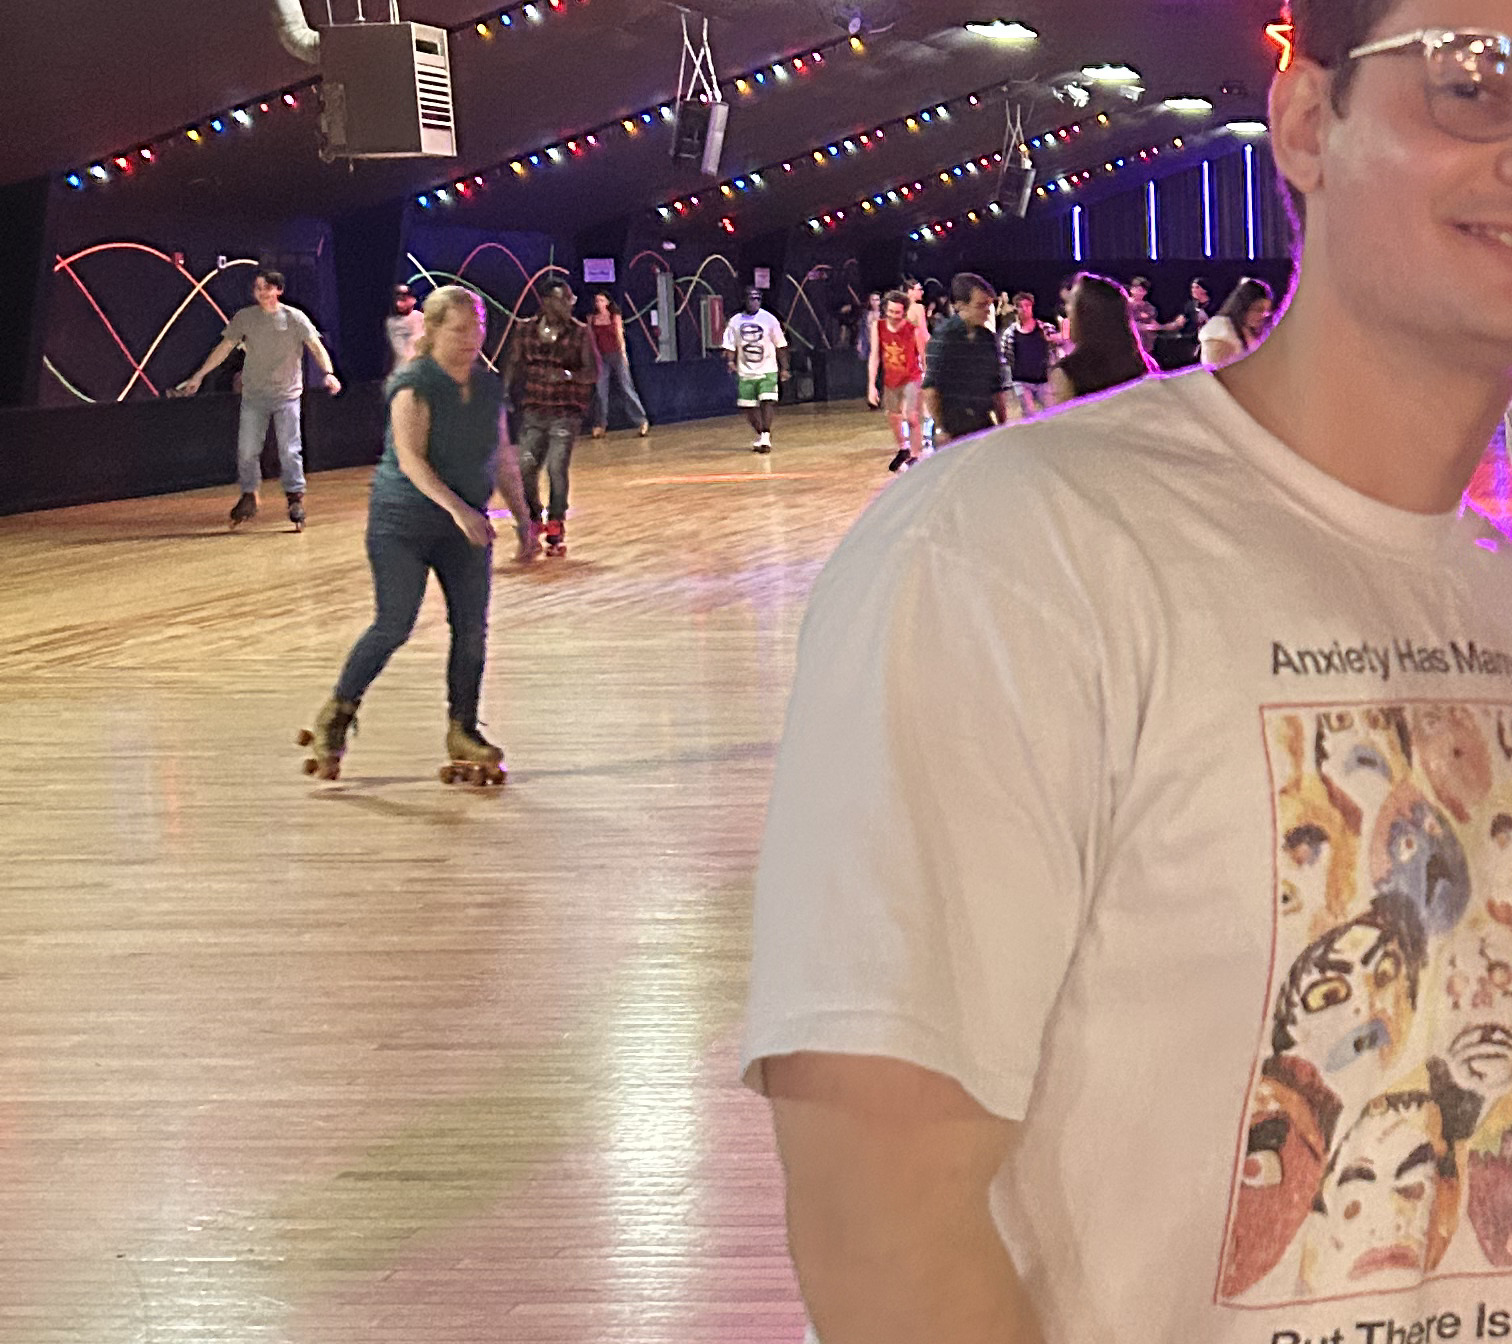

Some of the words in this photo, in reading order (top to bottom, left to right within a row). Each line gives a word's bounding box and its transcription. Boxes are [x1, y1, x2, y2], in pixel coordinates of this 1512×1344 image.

[1271, 640, 1391, 682] Anxiety
[1394, 638, 1450, 674] Has
[1475, 1301, 1512, 1339] Is
